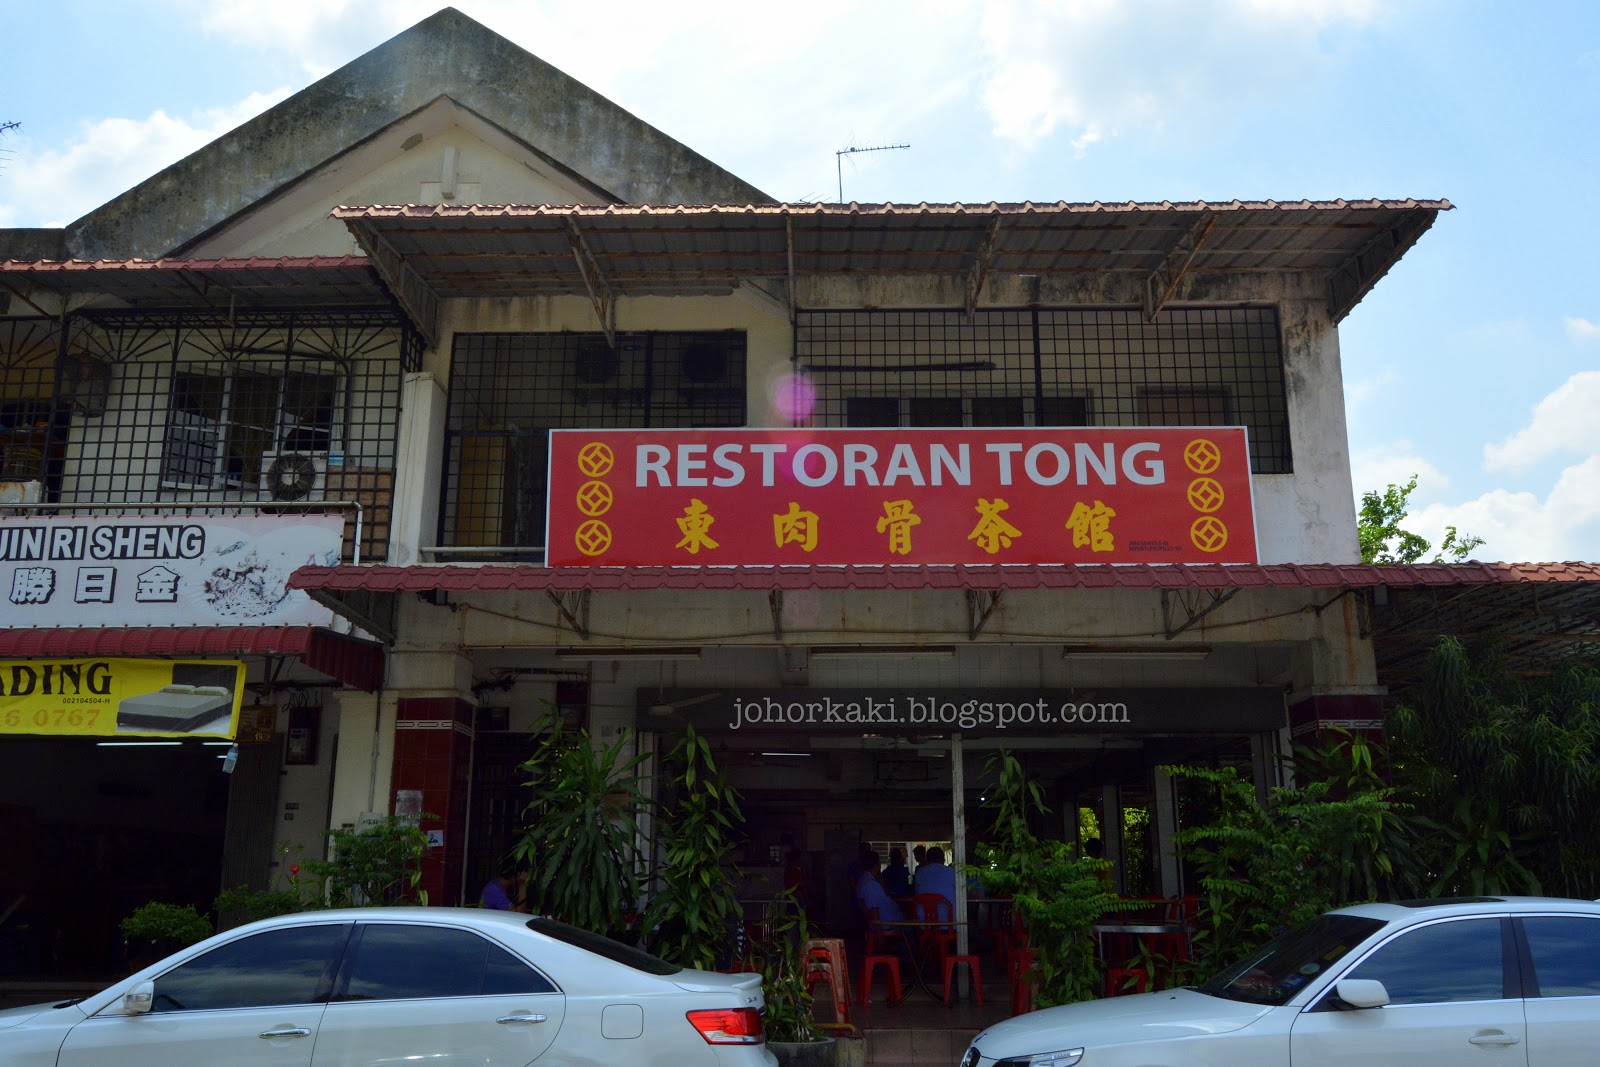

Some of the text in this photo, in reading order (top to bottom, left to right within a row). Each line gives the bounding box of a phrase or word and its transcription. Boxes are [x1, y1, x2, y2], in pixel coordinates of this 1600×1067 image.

[635, 442, 1166, 488] RESTORAN TONG
[0, 525, 206, 562] JIN RI SHENG
[33, 708, 101, 727] 0767
